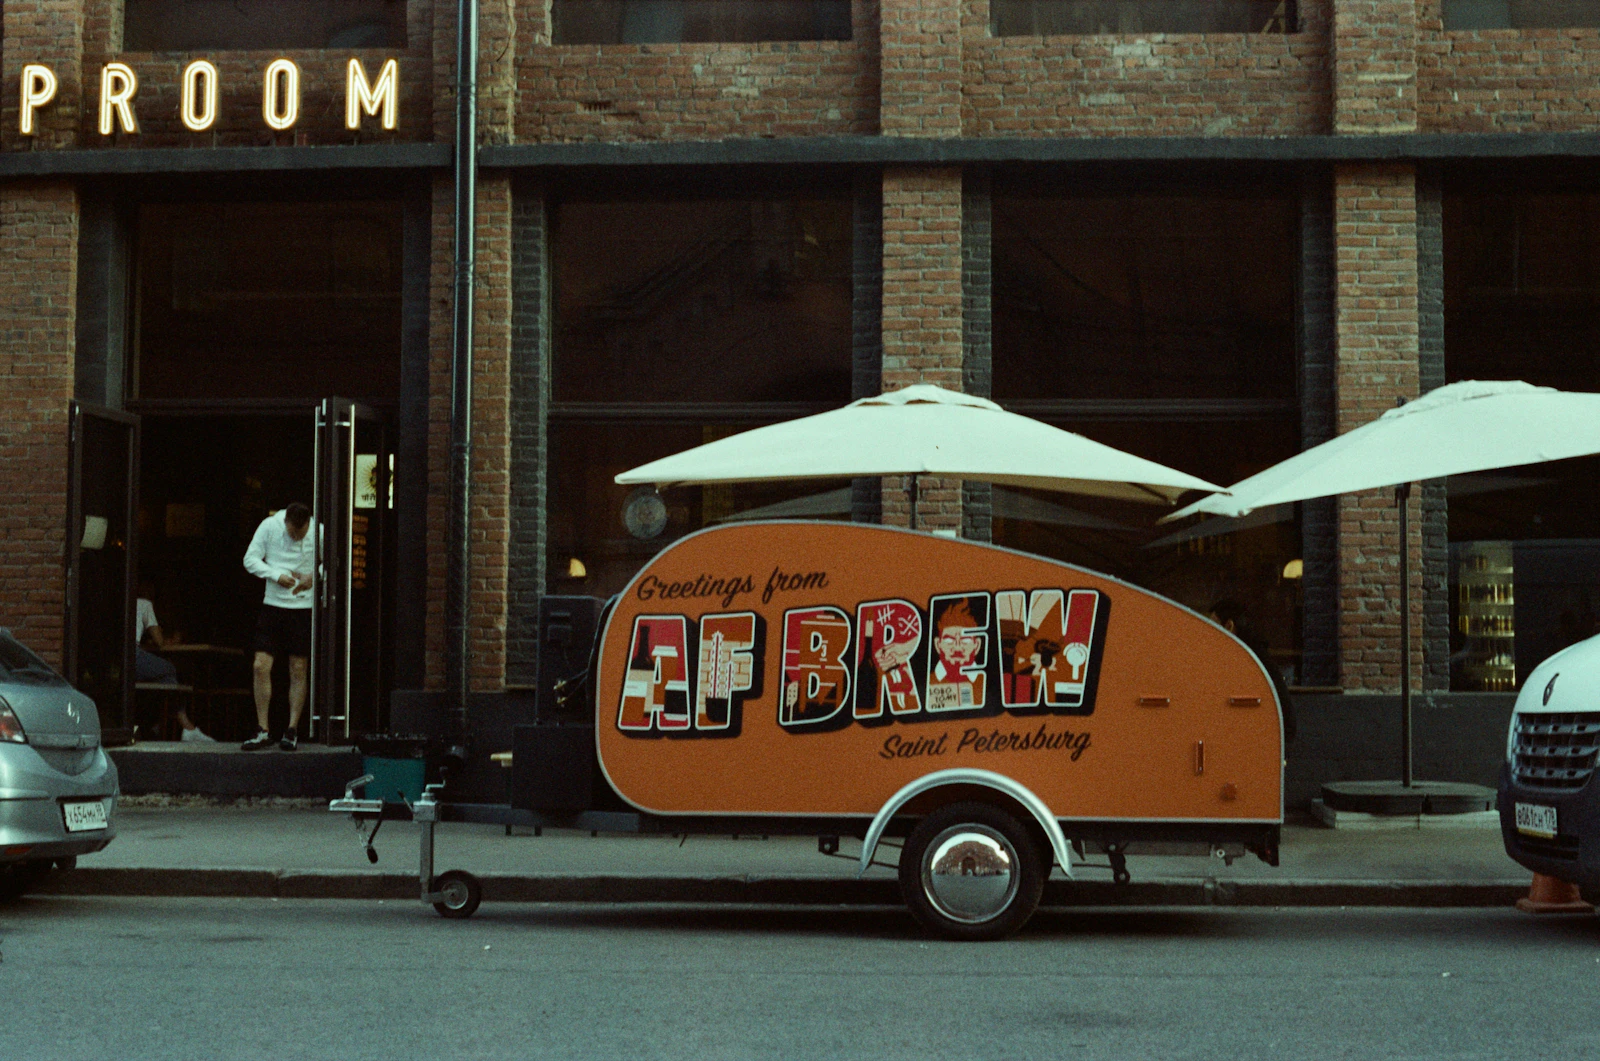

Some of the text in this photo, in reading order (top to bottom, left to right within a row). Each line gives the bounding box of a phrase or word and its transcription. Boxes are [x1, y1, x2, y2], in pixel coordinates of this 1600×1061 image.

[19, 58, 399, 135] PROOM
[637, 566, 829, 608] Greetings from
[616, 588, 1106, 734] AF BREW
[878, 723, 1091, 762] Saint Petersburg
